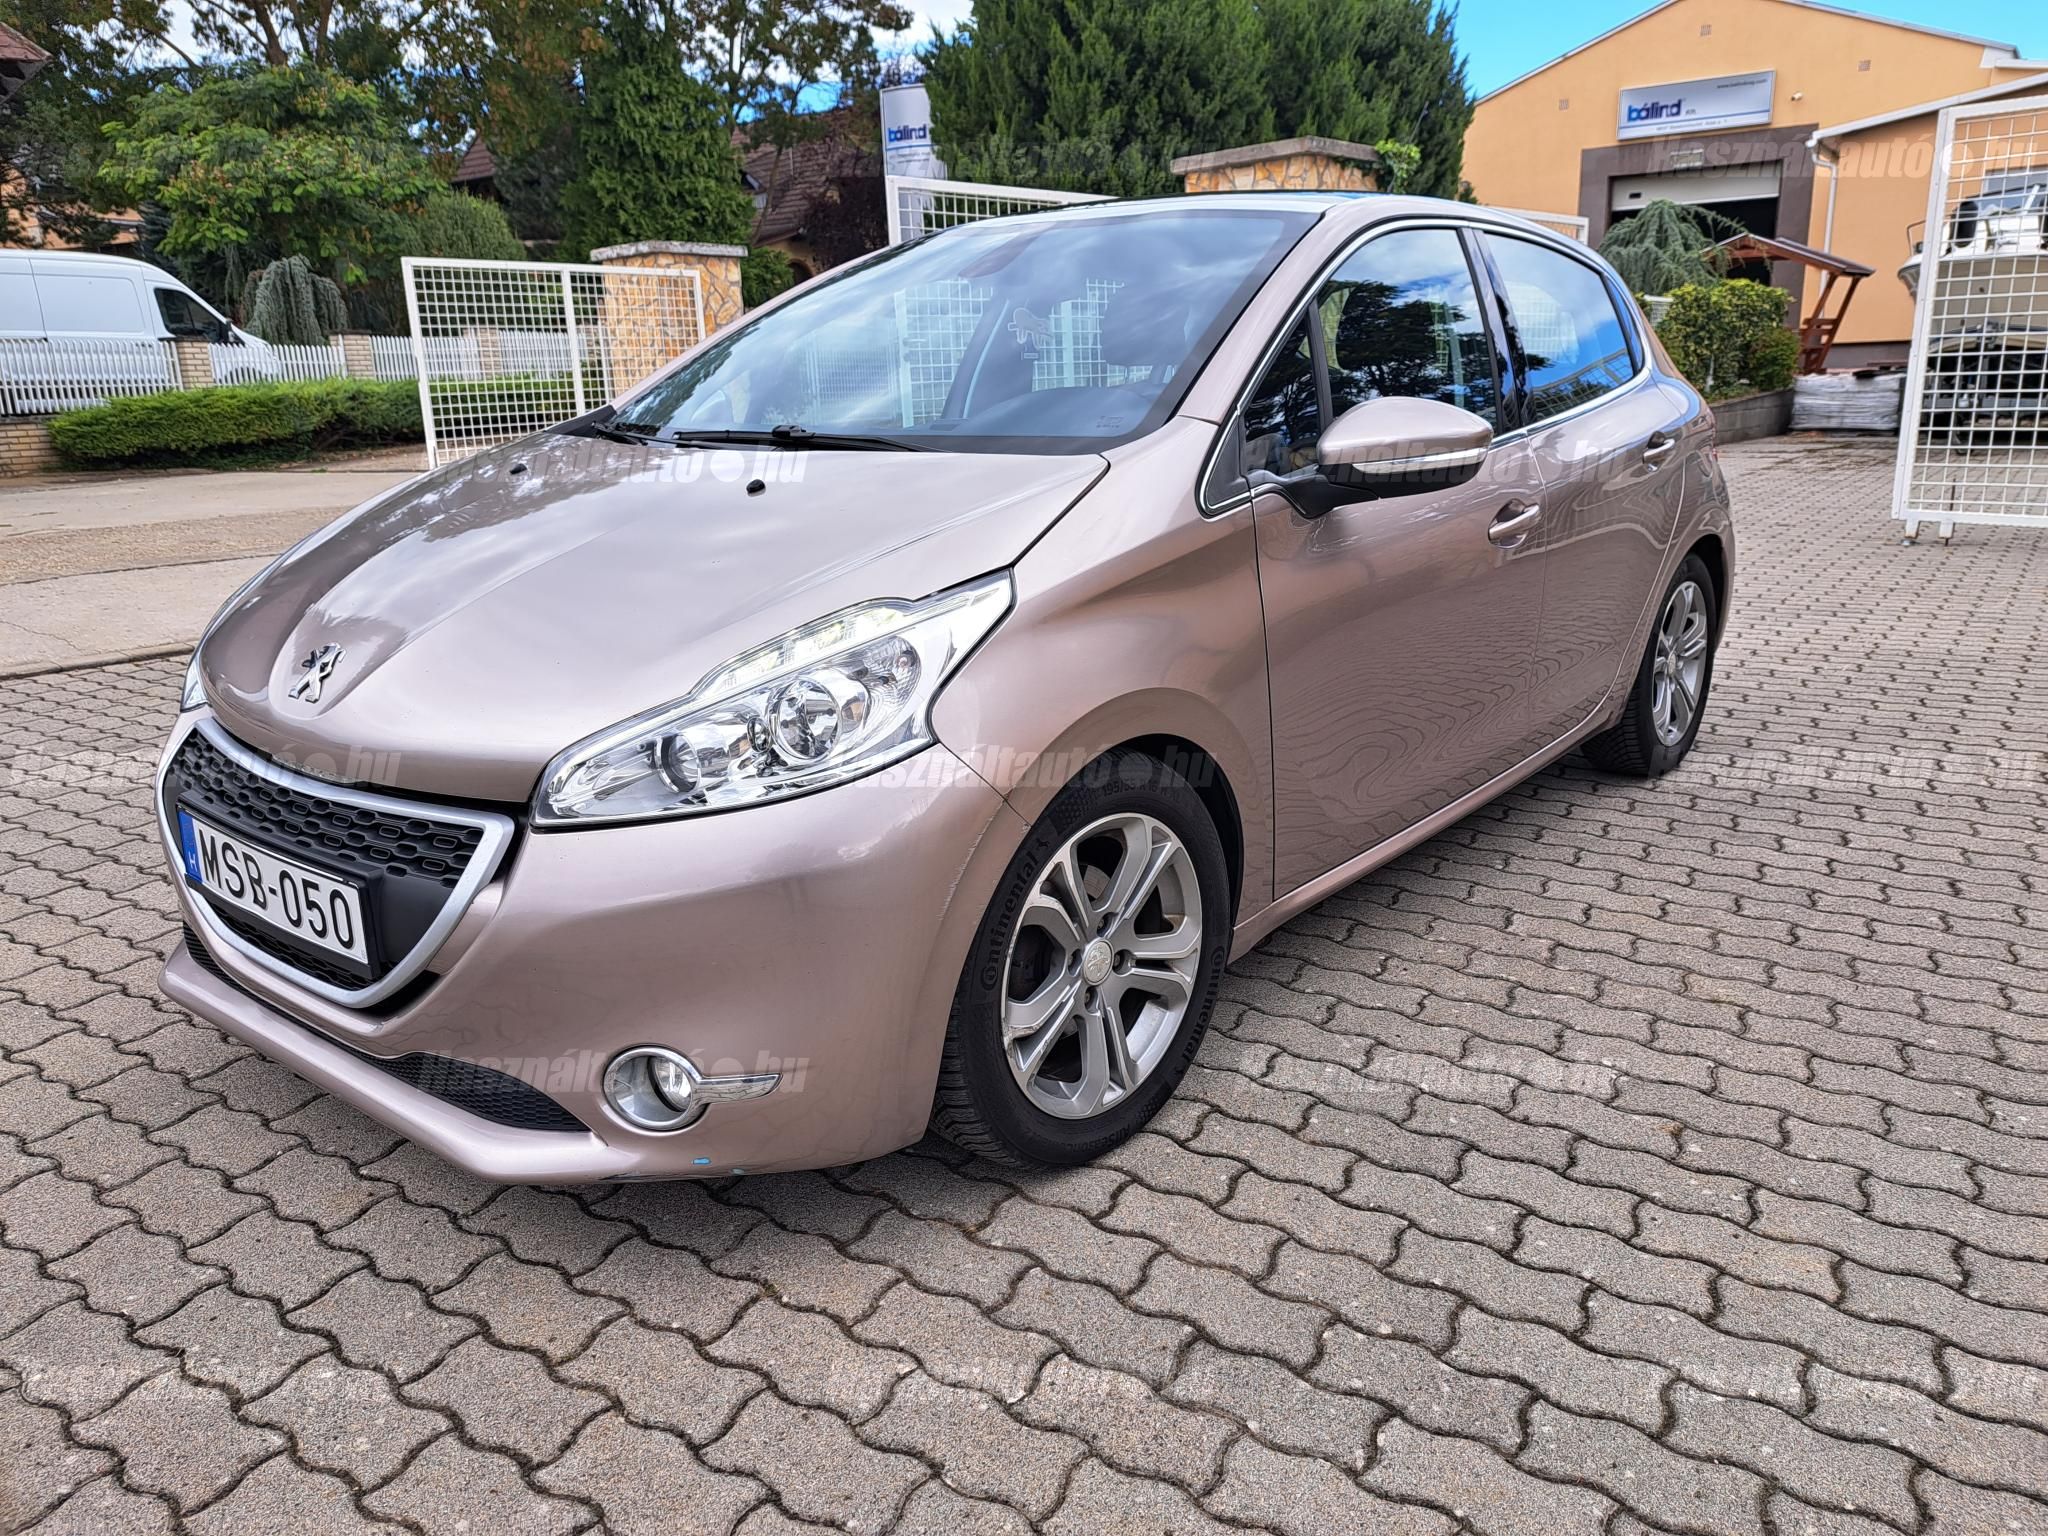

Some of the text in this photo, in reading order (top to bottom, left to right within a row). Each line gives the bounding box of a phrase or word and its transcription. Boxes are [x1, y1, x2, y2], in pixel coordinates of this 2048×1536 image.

[1627, 98, 1683, 122] bálind
[888, 124, 927, 142] bálind
[187, 851, 198, 872] H
[198, 828, 354, 950] MSB-050
[980, 850, 1039, 991] Continental
